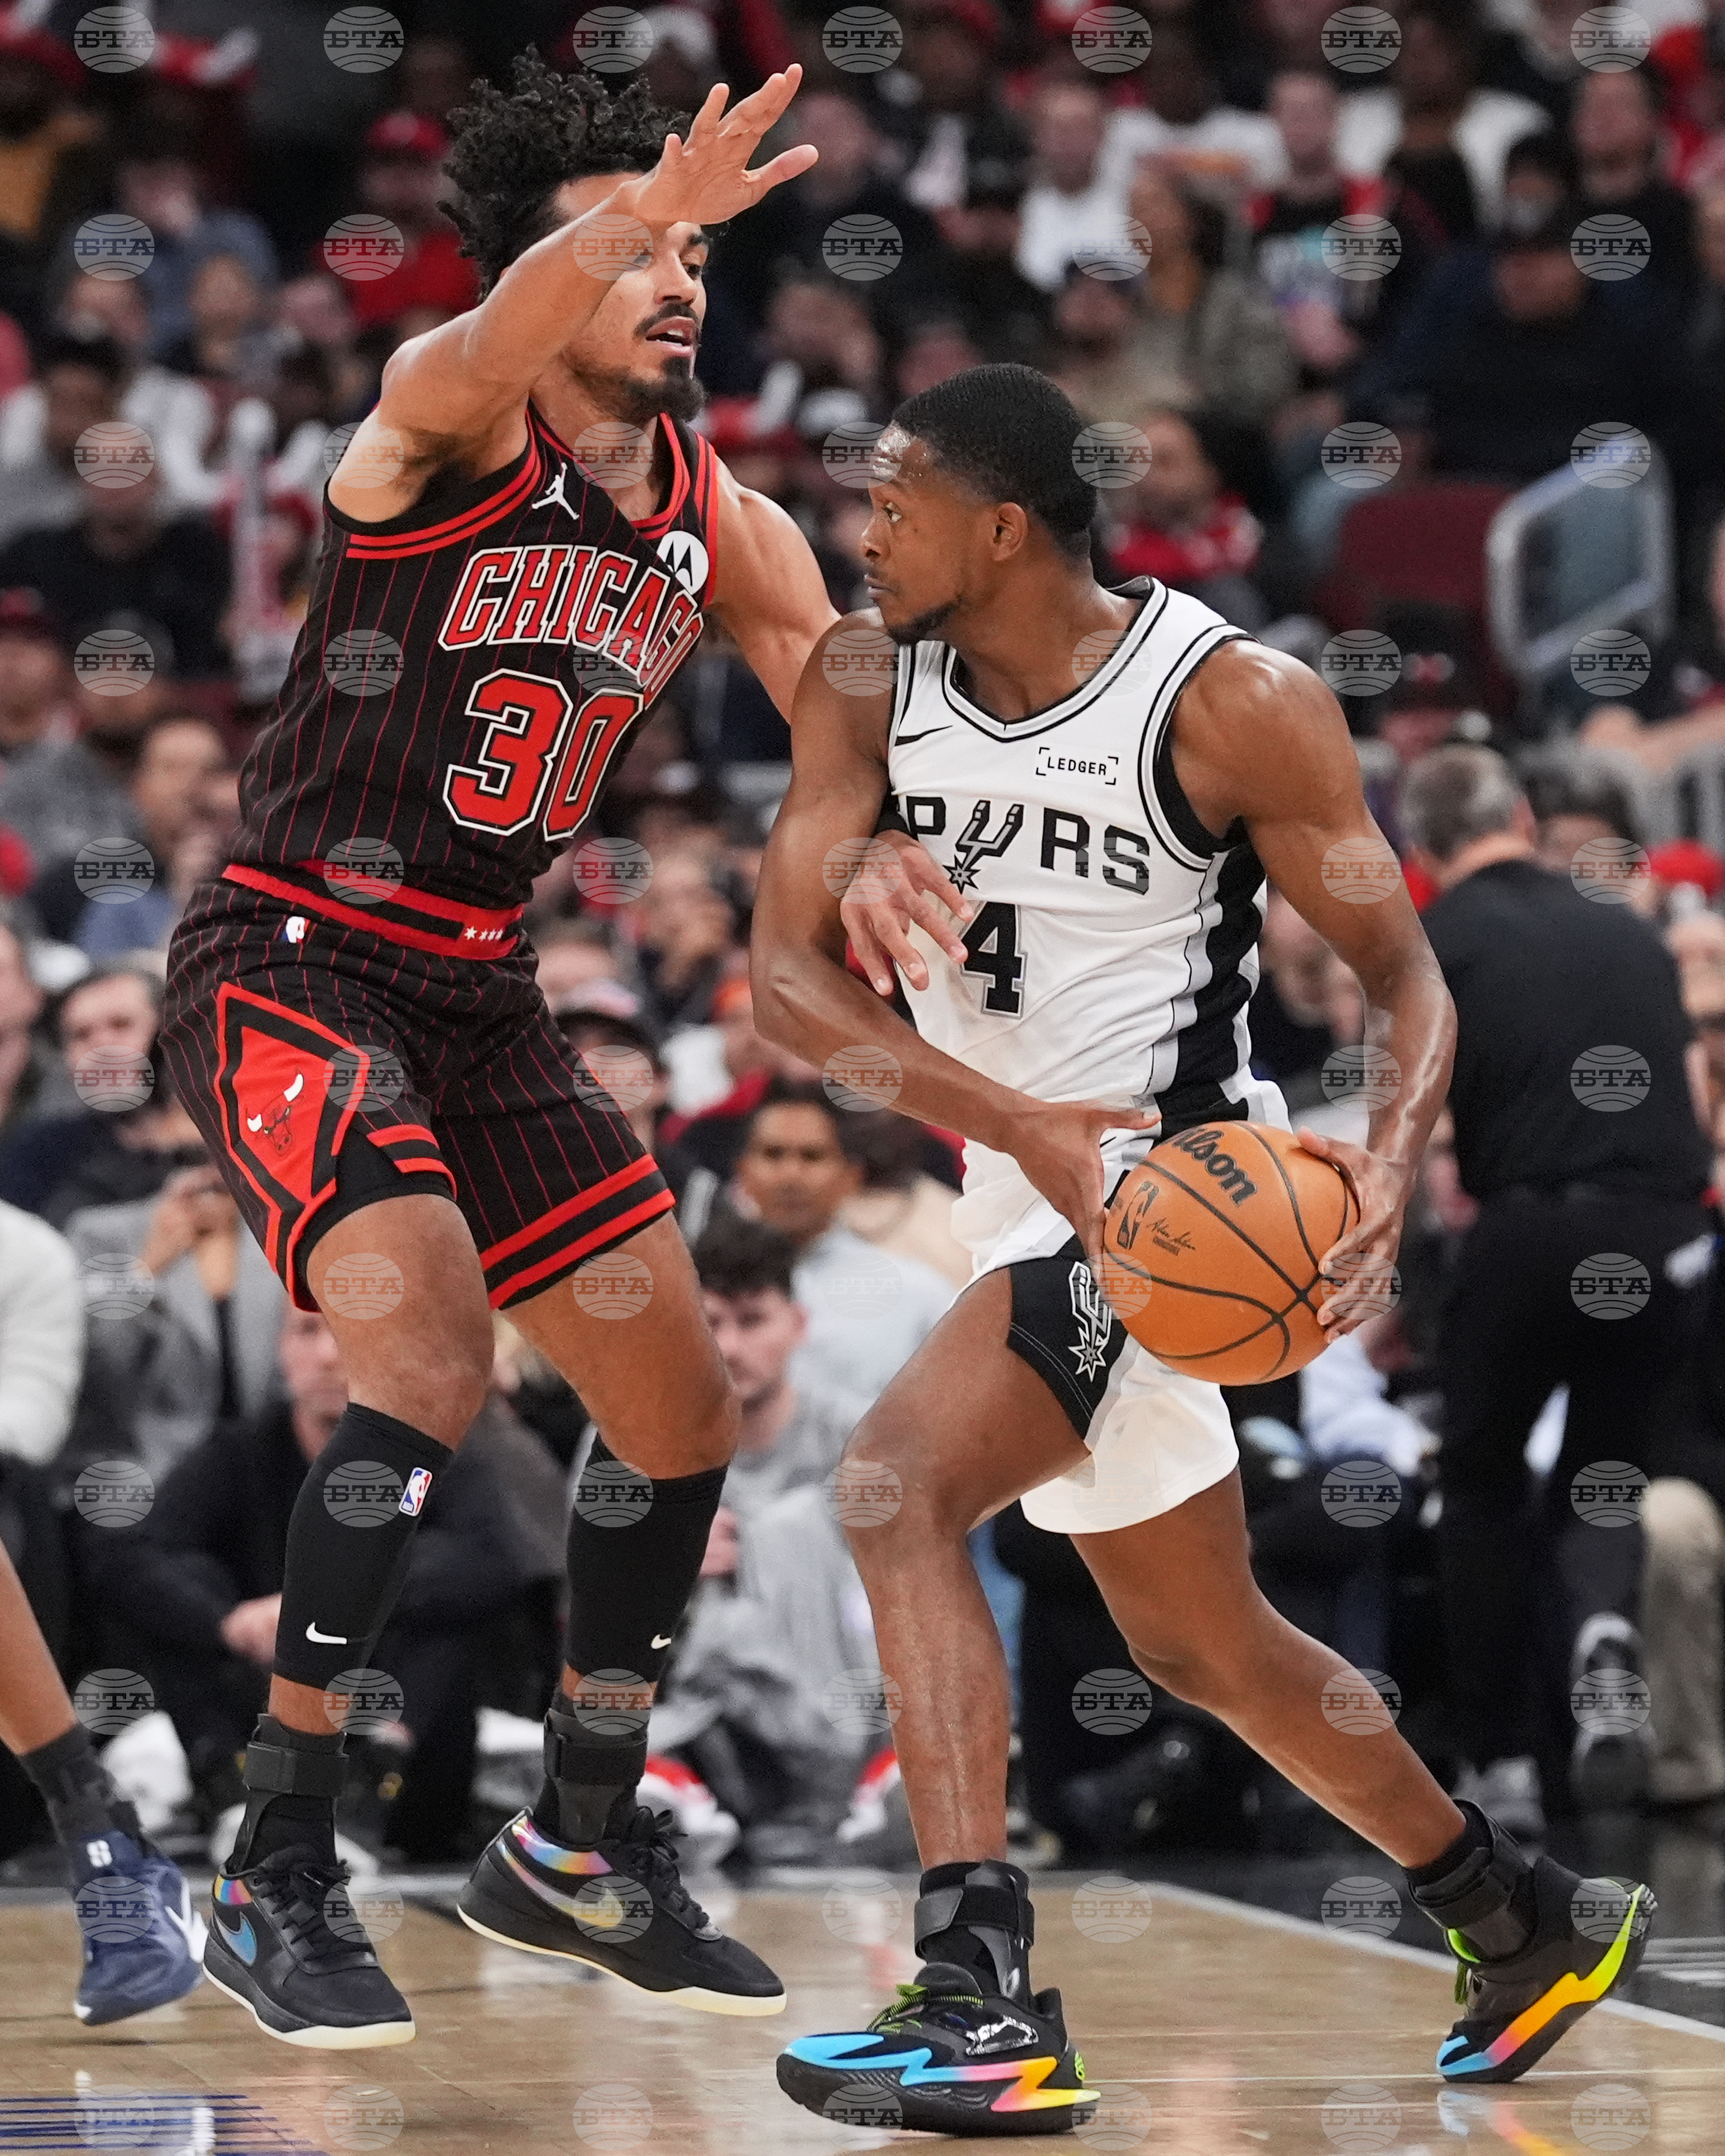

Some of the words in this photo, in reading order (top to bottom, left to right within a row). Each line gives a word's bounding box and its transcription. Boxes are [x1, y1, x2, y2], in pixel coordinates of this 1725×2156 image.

[438, 544, 705, 711] CHICAGO
[443, 668, 644, 842] 30
[1047, 756, 1107, 776] LEDGER
[905, 795, 1150, 896] PURS
[962, 901, 1028, 1019] 4
[1161, 1127, 1258, 1208] ilson
